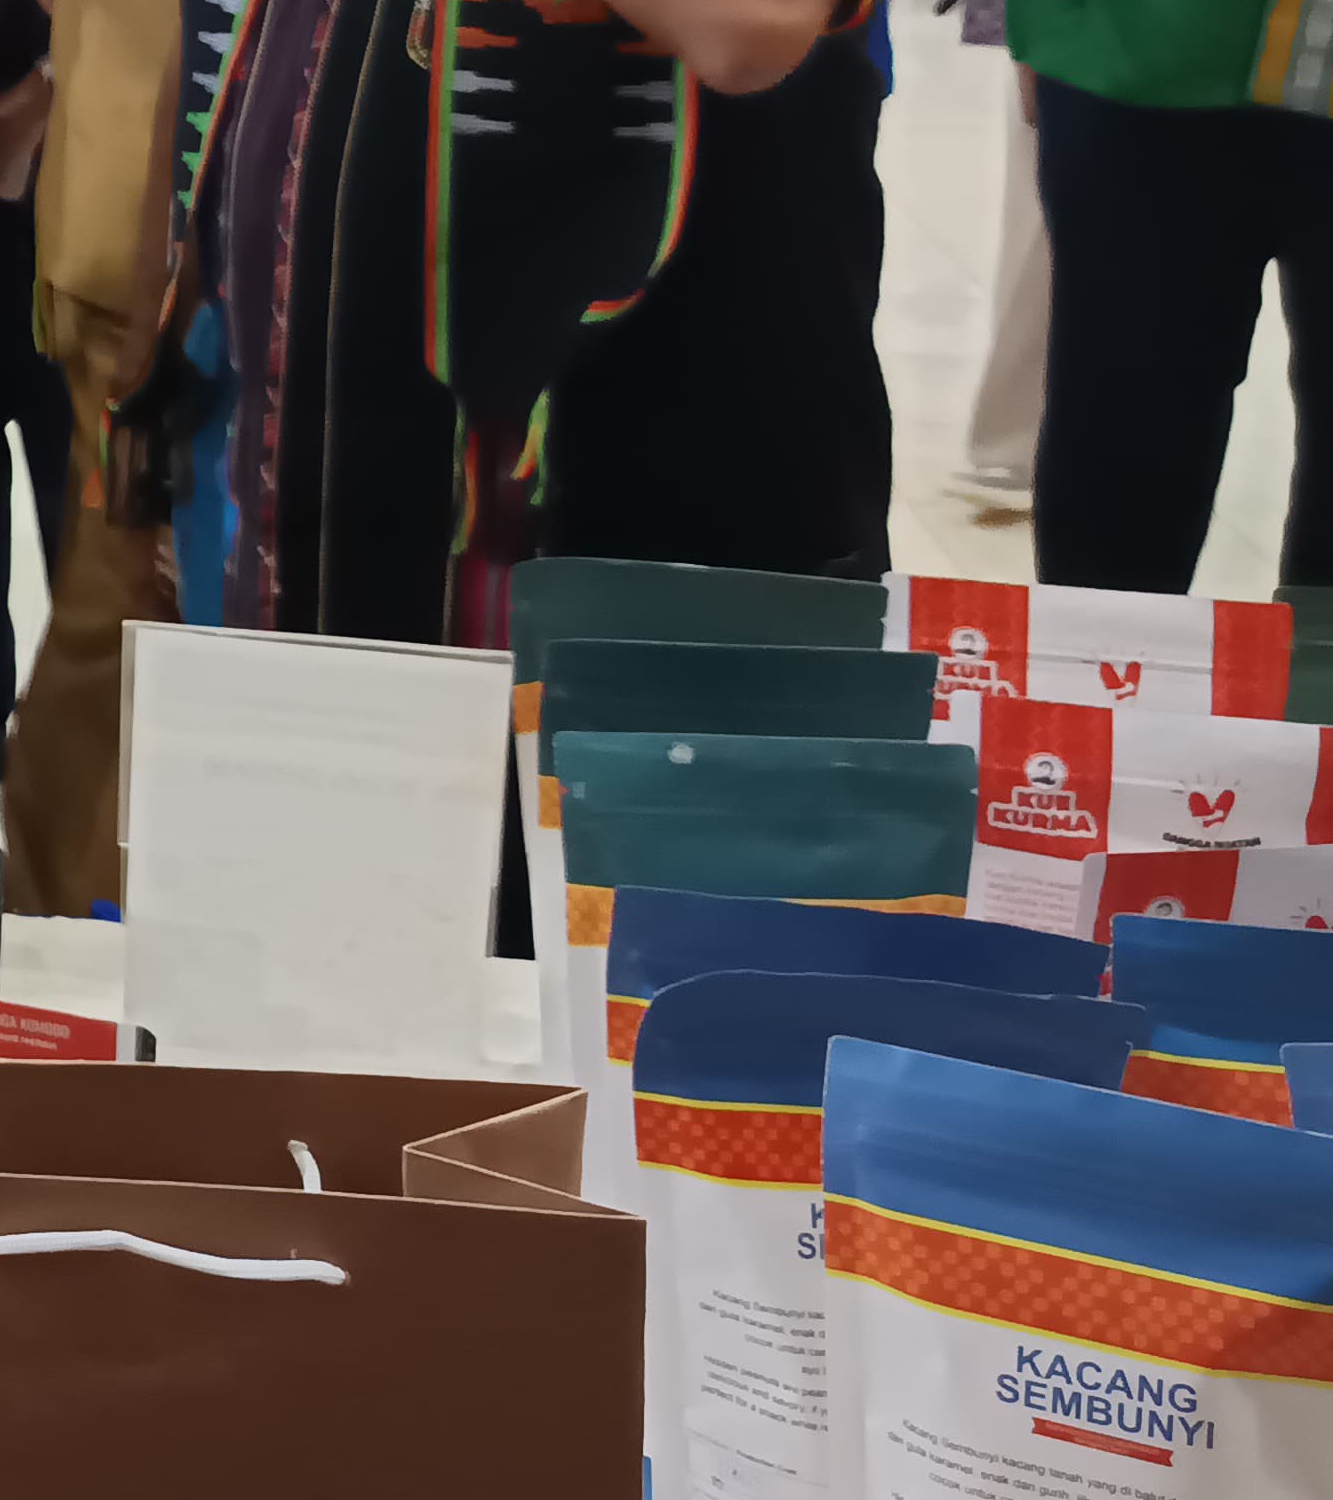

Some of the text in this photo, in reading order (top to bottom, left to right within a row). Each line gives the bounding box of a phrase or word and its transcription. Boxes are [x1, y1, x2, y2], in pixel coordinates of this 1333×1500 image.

[20, 1019, 69, 1037] KOMODO
[1016, 1346, 1198, 1413] KACANG
[996, 1374, 1214, 1449] SEMBUNYI
[1002, 1455, 1045, 1477] kacang
[1087, 1479, 1117, 1495] yang
